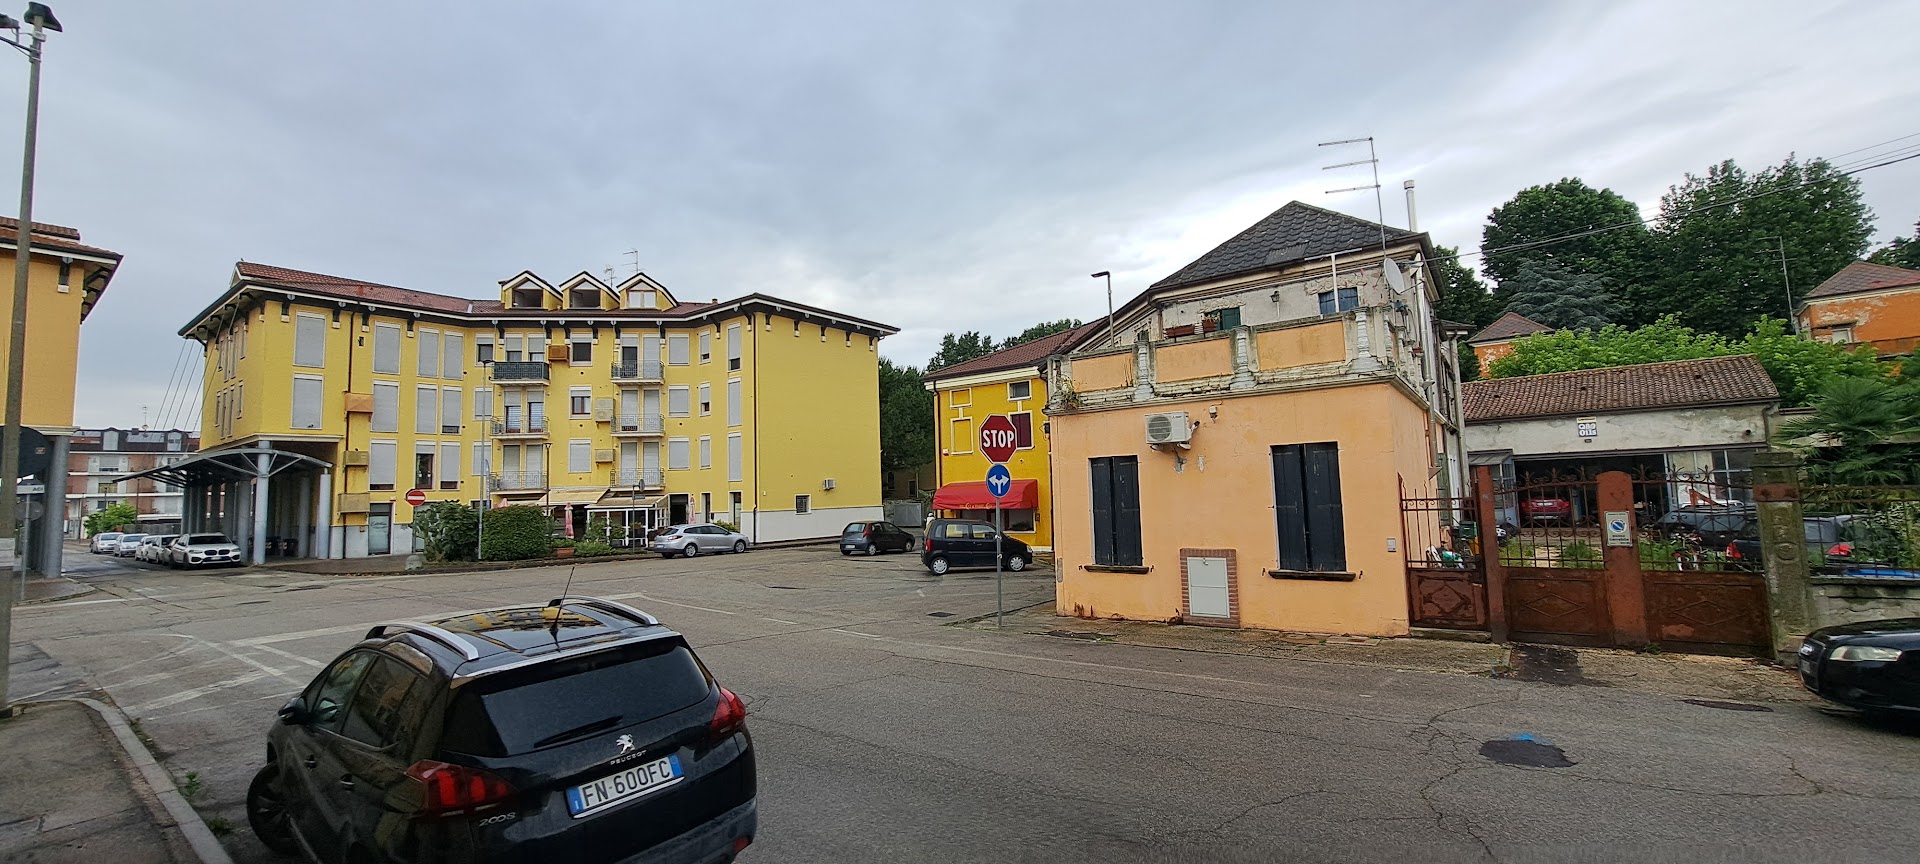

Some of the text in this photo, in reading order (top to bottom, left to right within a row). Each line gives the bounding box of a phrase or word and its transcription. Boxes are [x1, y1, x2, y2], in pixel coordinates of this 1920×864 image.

[982, 429, 1015, 448] STOP
[609, 749, 647, 766] PEUGEOT
[582, 760, 670, 807] FN 600FC
[479, 811, 516, 827] 2008
